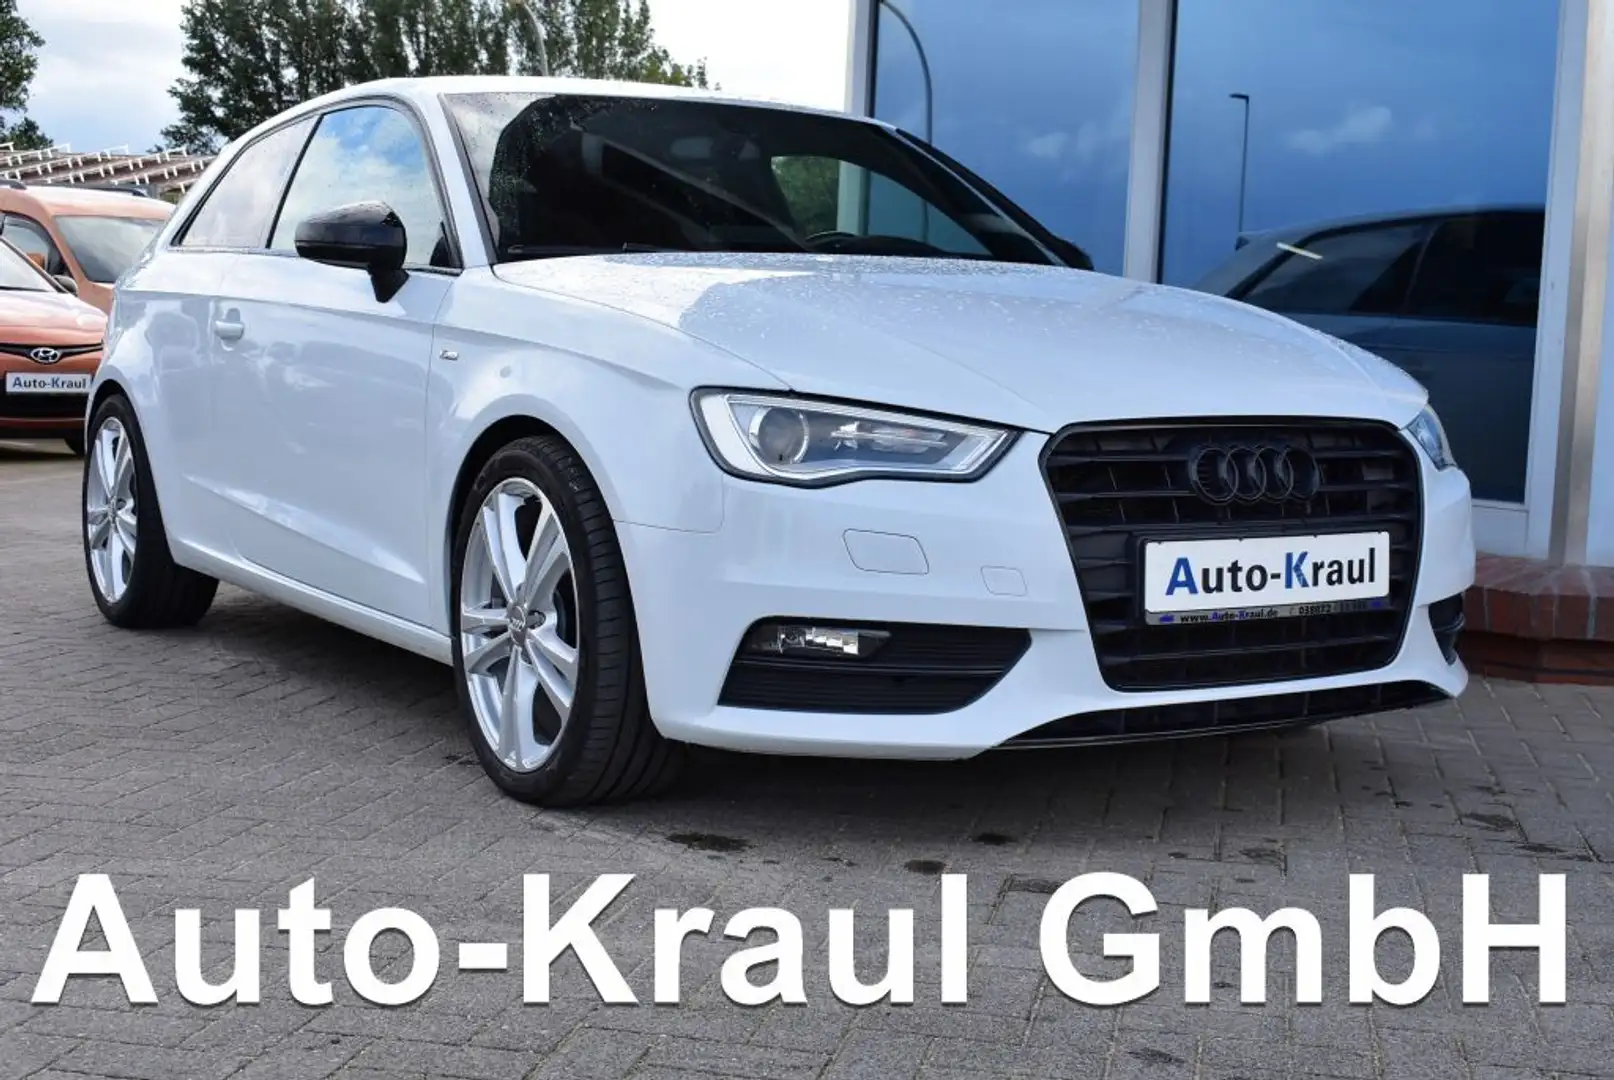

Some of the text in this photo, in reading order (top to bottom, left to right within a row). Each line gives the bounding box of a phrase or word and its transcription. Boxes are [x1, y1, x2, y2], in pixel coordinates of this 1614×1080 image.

[12, 376, 87, 389] Auto-Kraul
[1165, 547, 1376, 596] Auto-Kraul
[1180, 608, 1279, 623] www.Auto-Kraul.de
